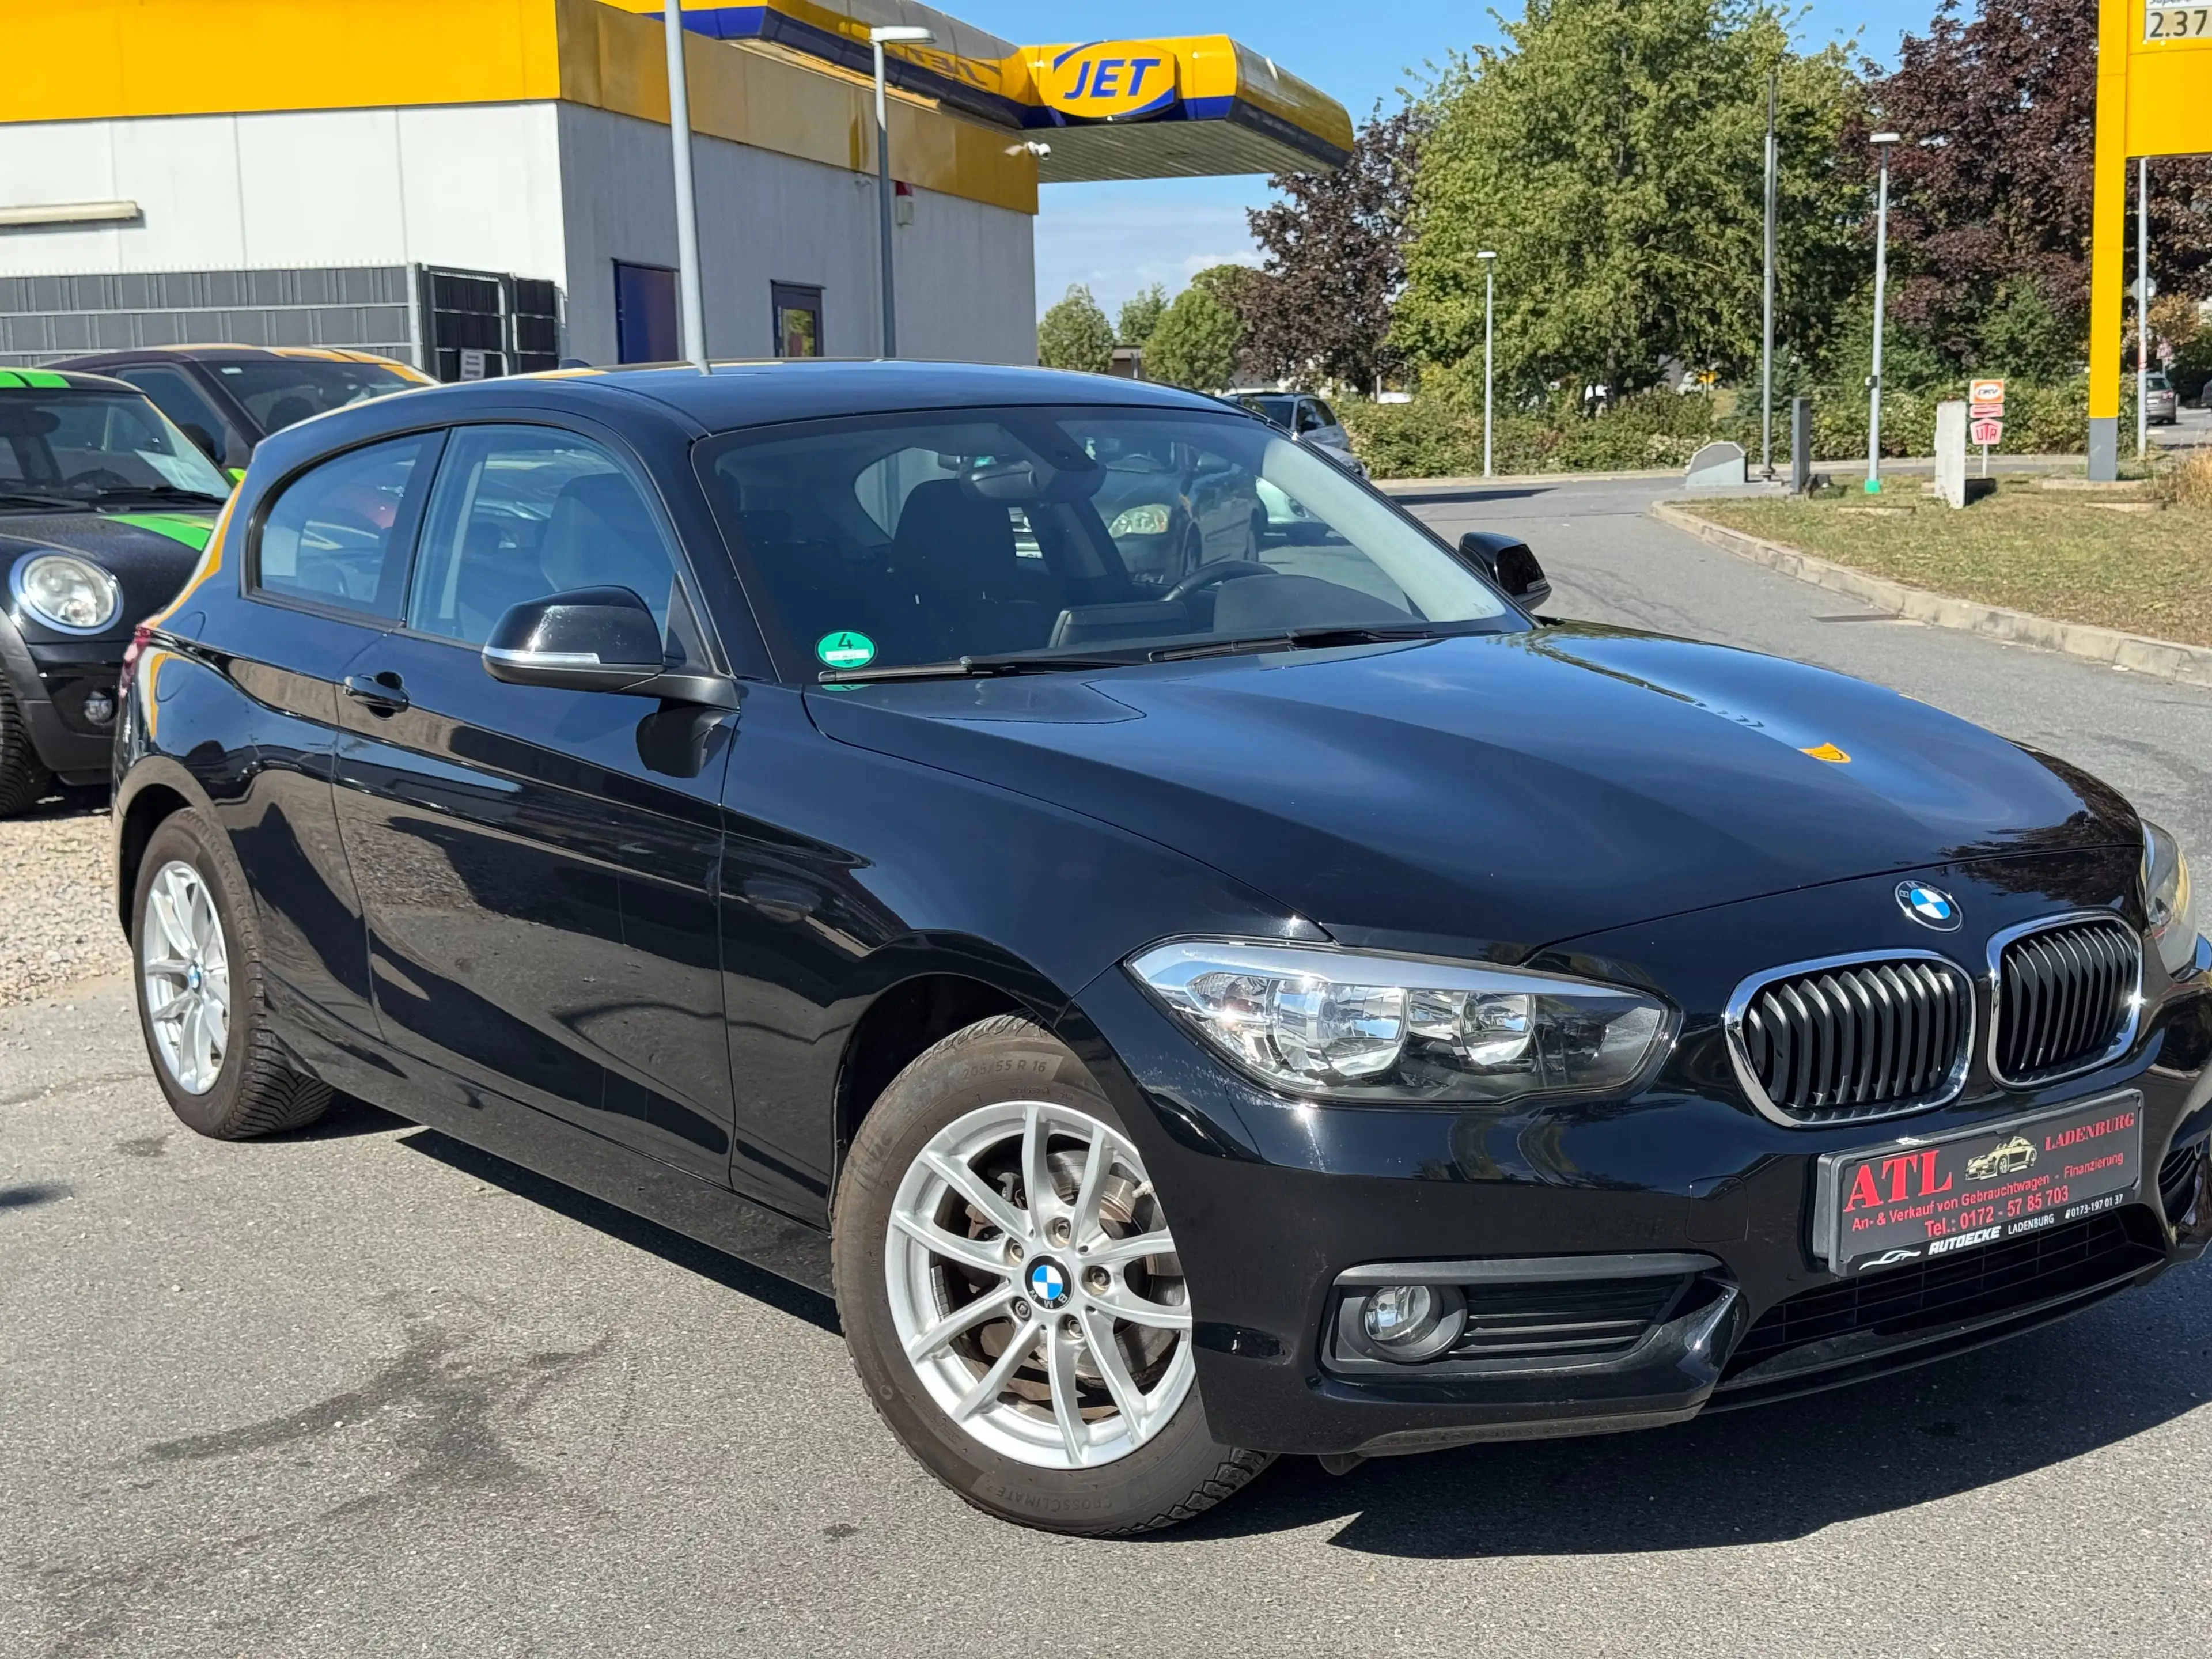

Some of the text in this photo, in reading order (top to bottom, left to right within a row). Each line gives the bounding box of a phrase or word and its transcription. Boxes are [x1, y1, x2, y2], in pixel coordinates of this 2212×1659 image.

[2149, 9, 2208, 38] 2.37
[1063, 58, 1161, 100] JET
[838, 633, 854, 650] 4
[1032, 1060, 1047, 1073] 16
[2045, 1112, 2134, 1151] LADENBURG
[1843, 1150, 1952, 1212] ATL
[1852, 1217, 1874, 1232] An-
[1876, 1212, 1887, 1226] &
[1889, 1200, 1935, 1223] Verkauf
[1937, 1198, 1958, 1212] von
[1961, 1175, 2050, 1206] Gebrauchtwagen
[2064, 1153, 2124, 1179] Finanzierung
[1925, 1217, 1956, 1238] Tel.:
[1960, 1206, 1994, 1229] 0172
[2007, 1198, 2022, 1217] 57
[2027, 1192, 2043, 1212] 85
[2046, 1185, 2069, 1206] 703
[1928, 1194, 2123, 1255] AUTOECKE LADENBURG 0173-197 01 37
[1029, 1290, 1068, 1308] BMW
